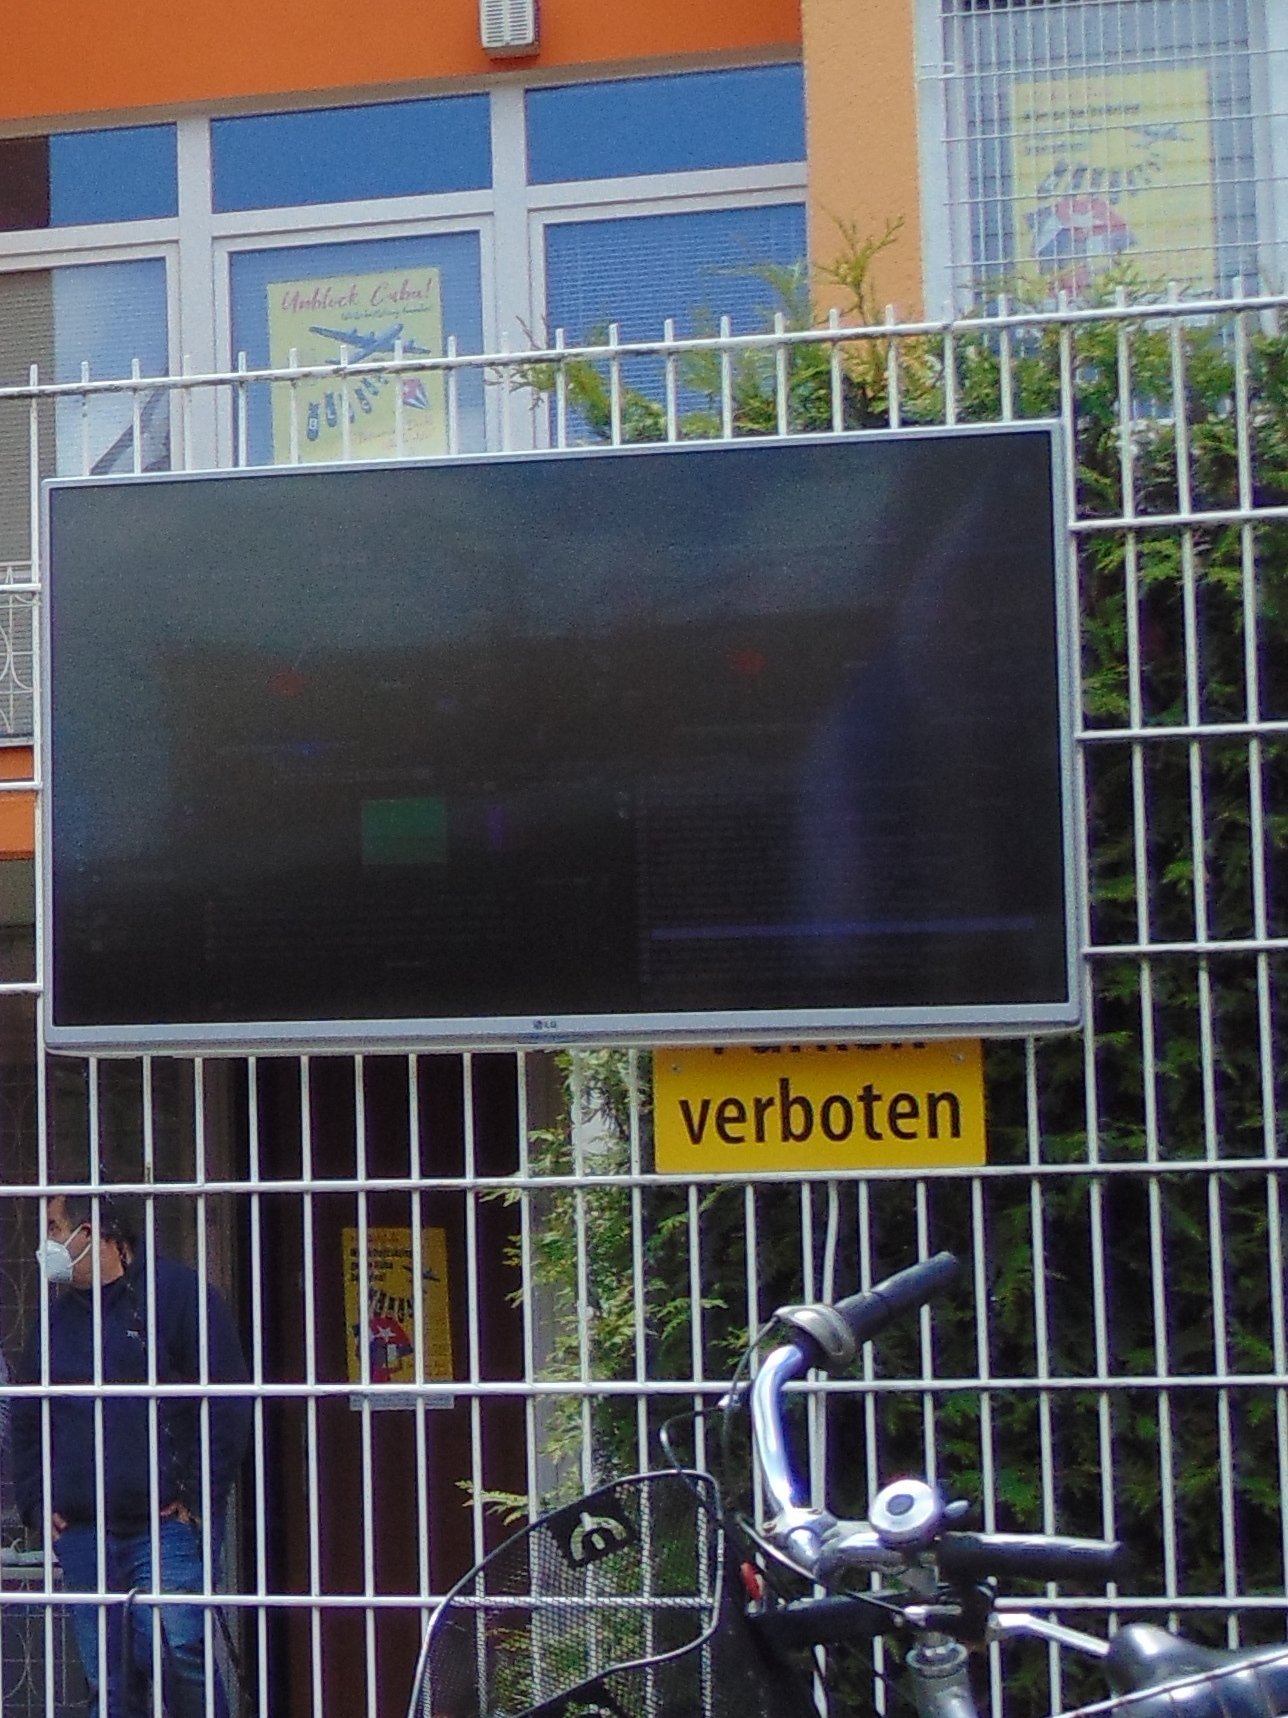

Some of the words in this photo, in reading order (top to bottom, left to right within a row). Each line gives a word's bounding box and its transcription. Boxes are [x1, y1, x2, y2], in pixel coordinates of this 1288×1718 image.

[281, 284, 358, 314] Unblock
[369, 277, 432, 307] Cuba!
[679, 1077, 961, 1145] verboten
